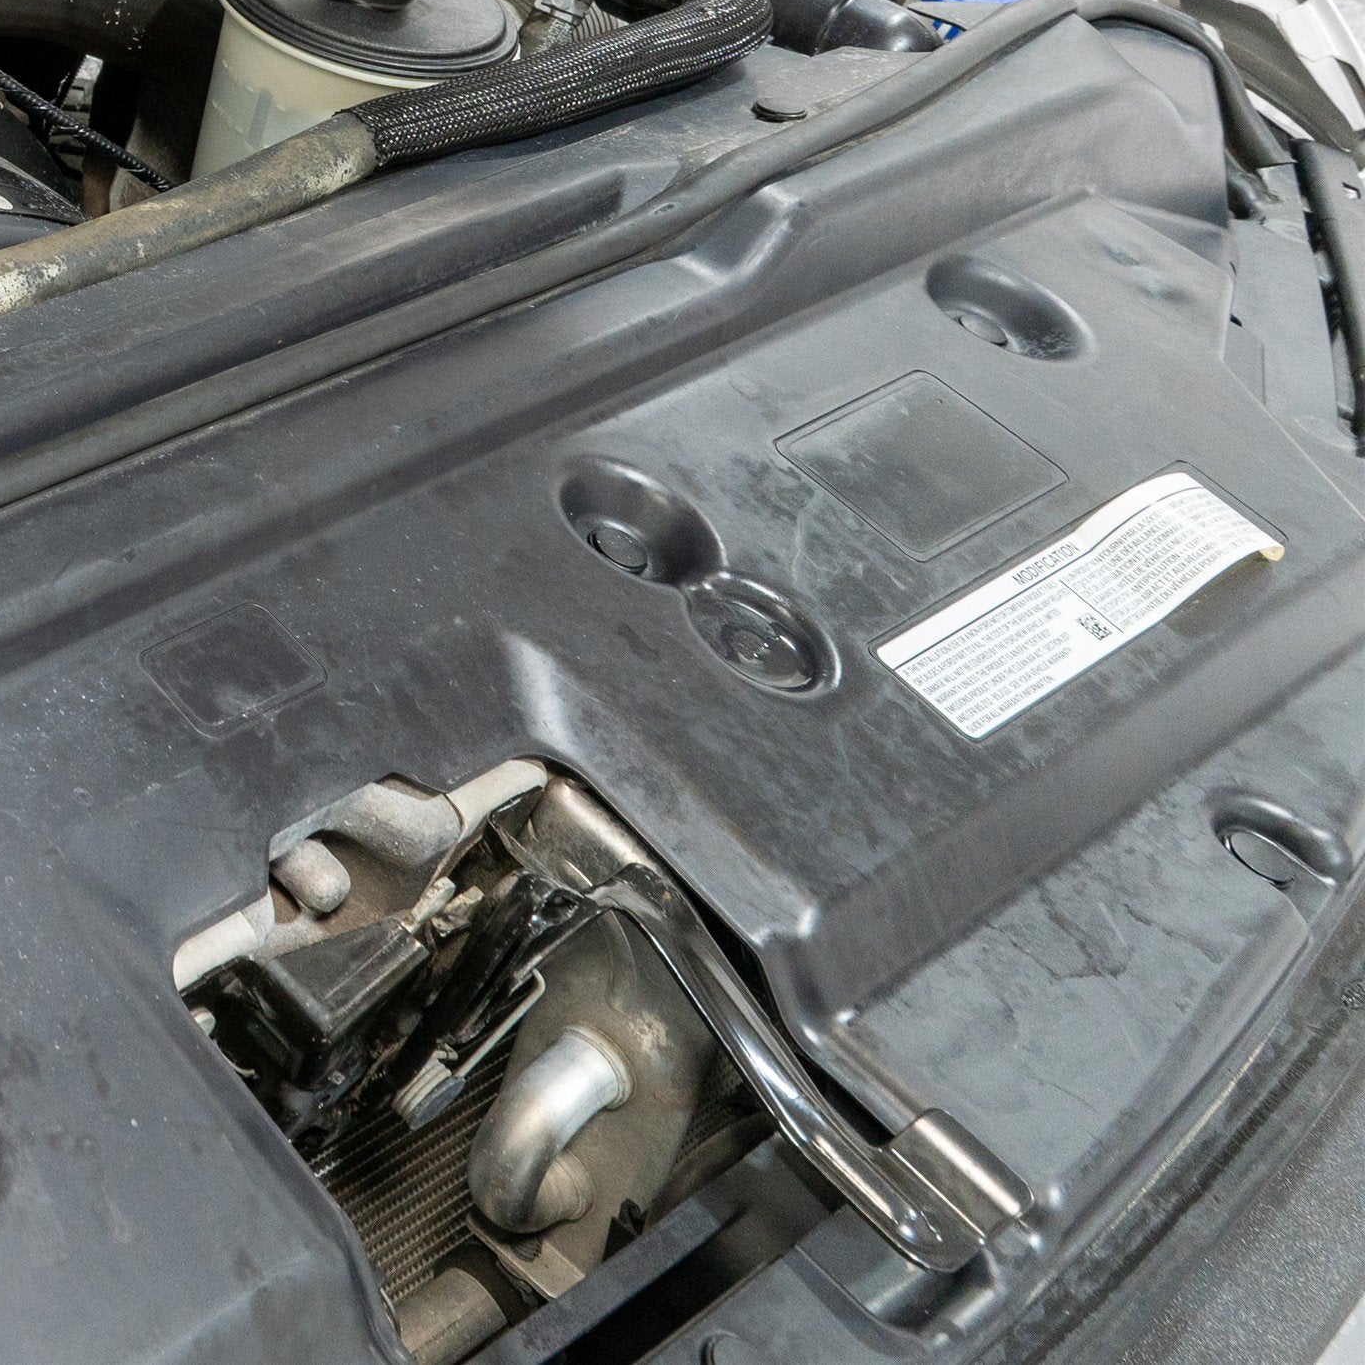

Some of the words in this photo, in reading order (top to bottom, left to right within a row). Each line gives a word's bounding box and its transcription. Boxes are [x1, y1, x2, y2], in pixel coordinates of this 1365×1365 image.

[1011, 540, 1082, 588] MODIFICATION
[1107, 554, 1122, 567] UNE
[1120, 525, 1160, 556] DÉFAILLANCE
[1132, 566, 1144, 575] DE
[1142, 544, 1173, 567] VÉHICULE
[1133, 550, 1145, 561] ET
[1141, 542, 1157, 553] LES
[1131, 553, 1183, 592] ANTIPOLLUTION
[1141, 589, 1153, 600] AIR
[1150, 579, 1165, 592] ACT
[1162, 571, 1174, 581] ET
[1171, 562, 1187, 574] AUX
[1159, 589, 1173, 600] DU
[1170, 567, 1202, 590] VÉHICULE
[1198, 554, 1219, 568] POUR
